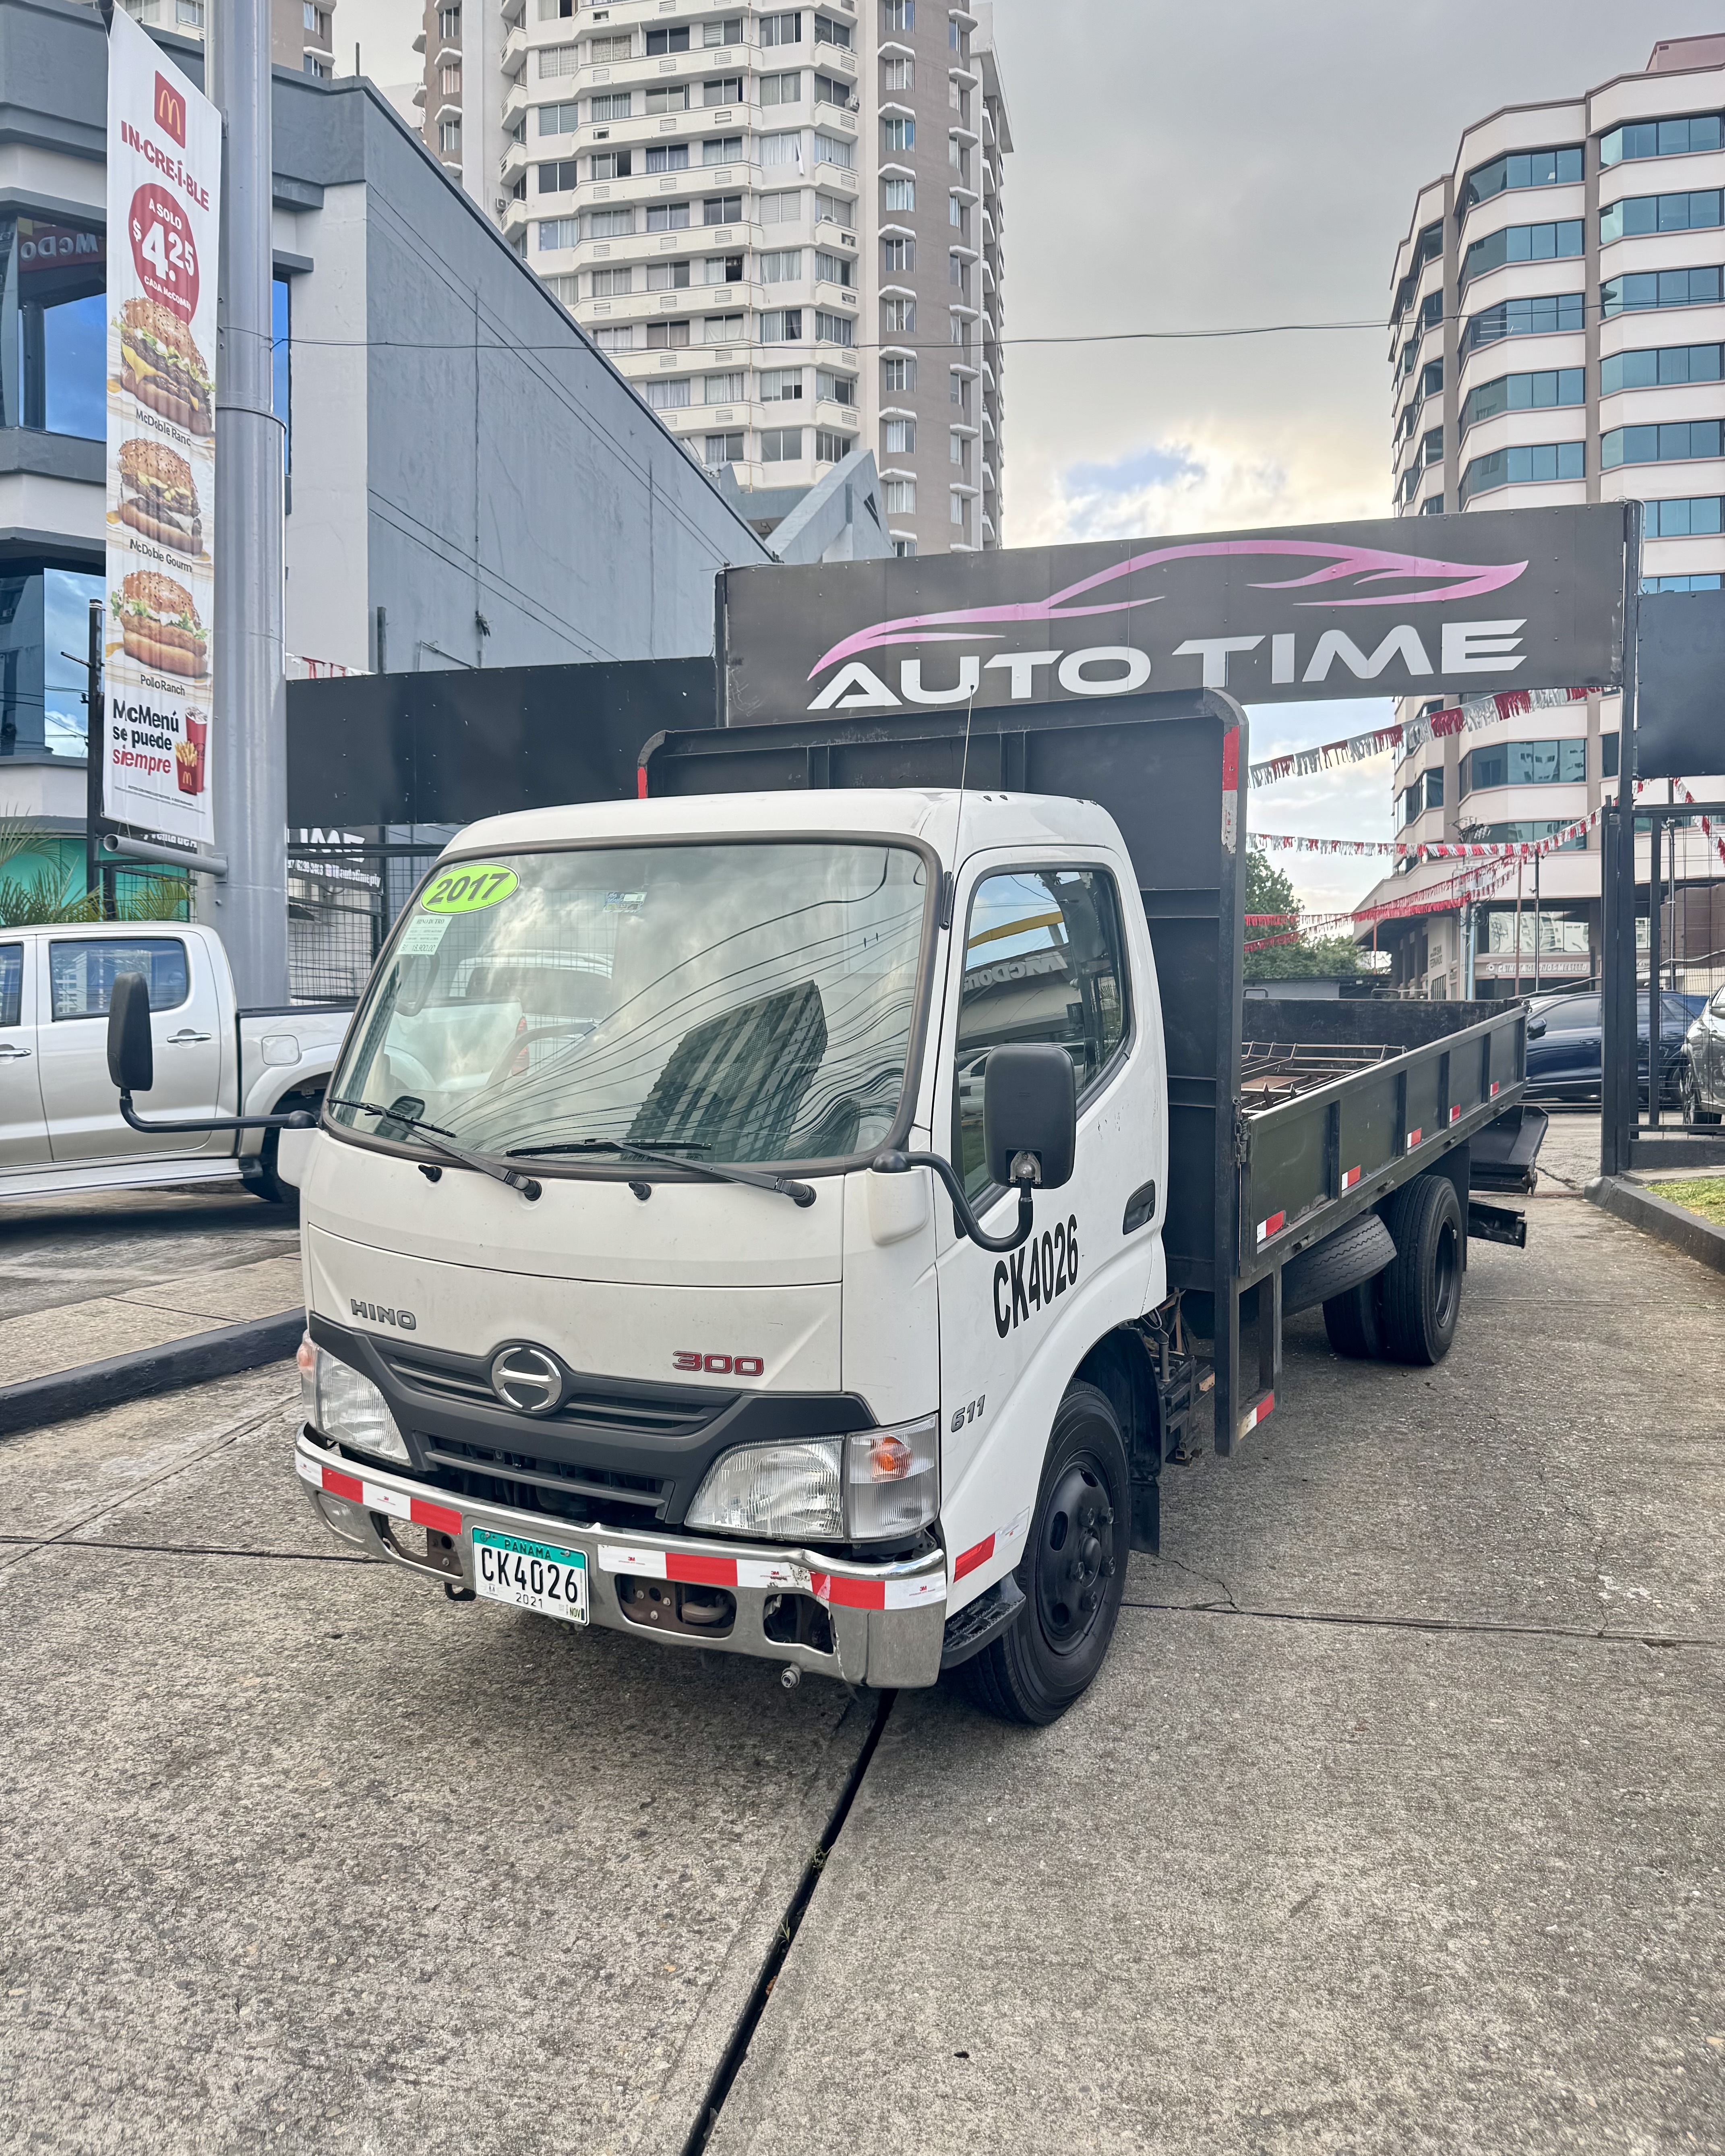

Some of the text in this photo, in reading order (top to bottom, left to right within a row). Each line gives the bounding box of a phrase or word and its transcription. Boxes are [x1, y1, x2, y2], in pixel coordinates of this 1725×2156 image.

[149, 198, 182, 230] A SOLO
[144, 275, 163, 294] CADA
[136, 408, 170, 436] McDoble
[130, 538, 164, 562] McDoble
[806, 618, 1528, 711] AUTO TIME
[113, 698, 179, 733] McMenú
[113, 726, 172, 751] se puede
[113, 744, 171, 776] siempre
[426, 872, 511, 906] 2017
[993, 1214, 1078, 1339] CK4026
[351, 1298, 416, 1330] HINO
[672, 1350, 764, 1376] 300
[951, 1394, 985, 1433] 611
[504, 1537, 553, 1561] PANAMA
[481, 1547, 578, 1604] CK4026
[516, 1592, 543, 1608] 2021
[569, 1606, 581, 1618] NOV
